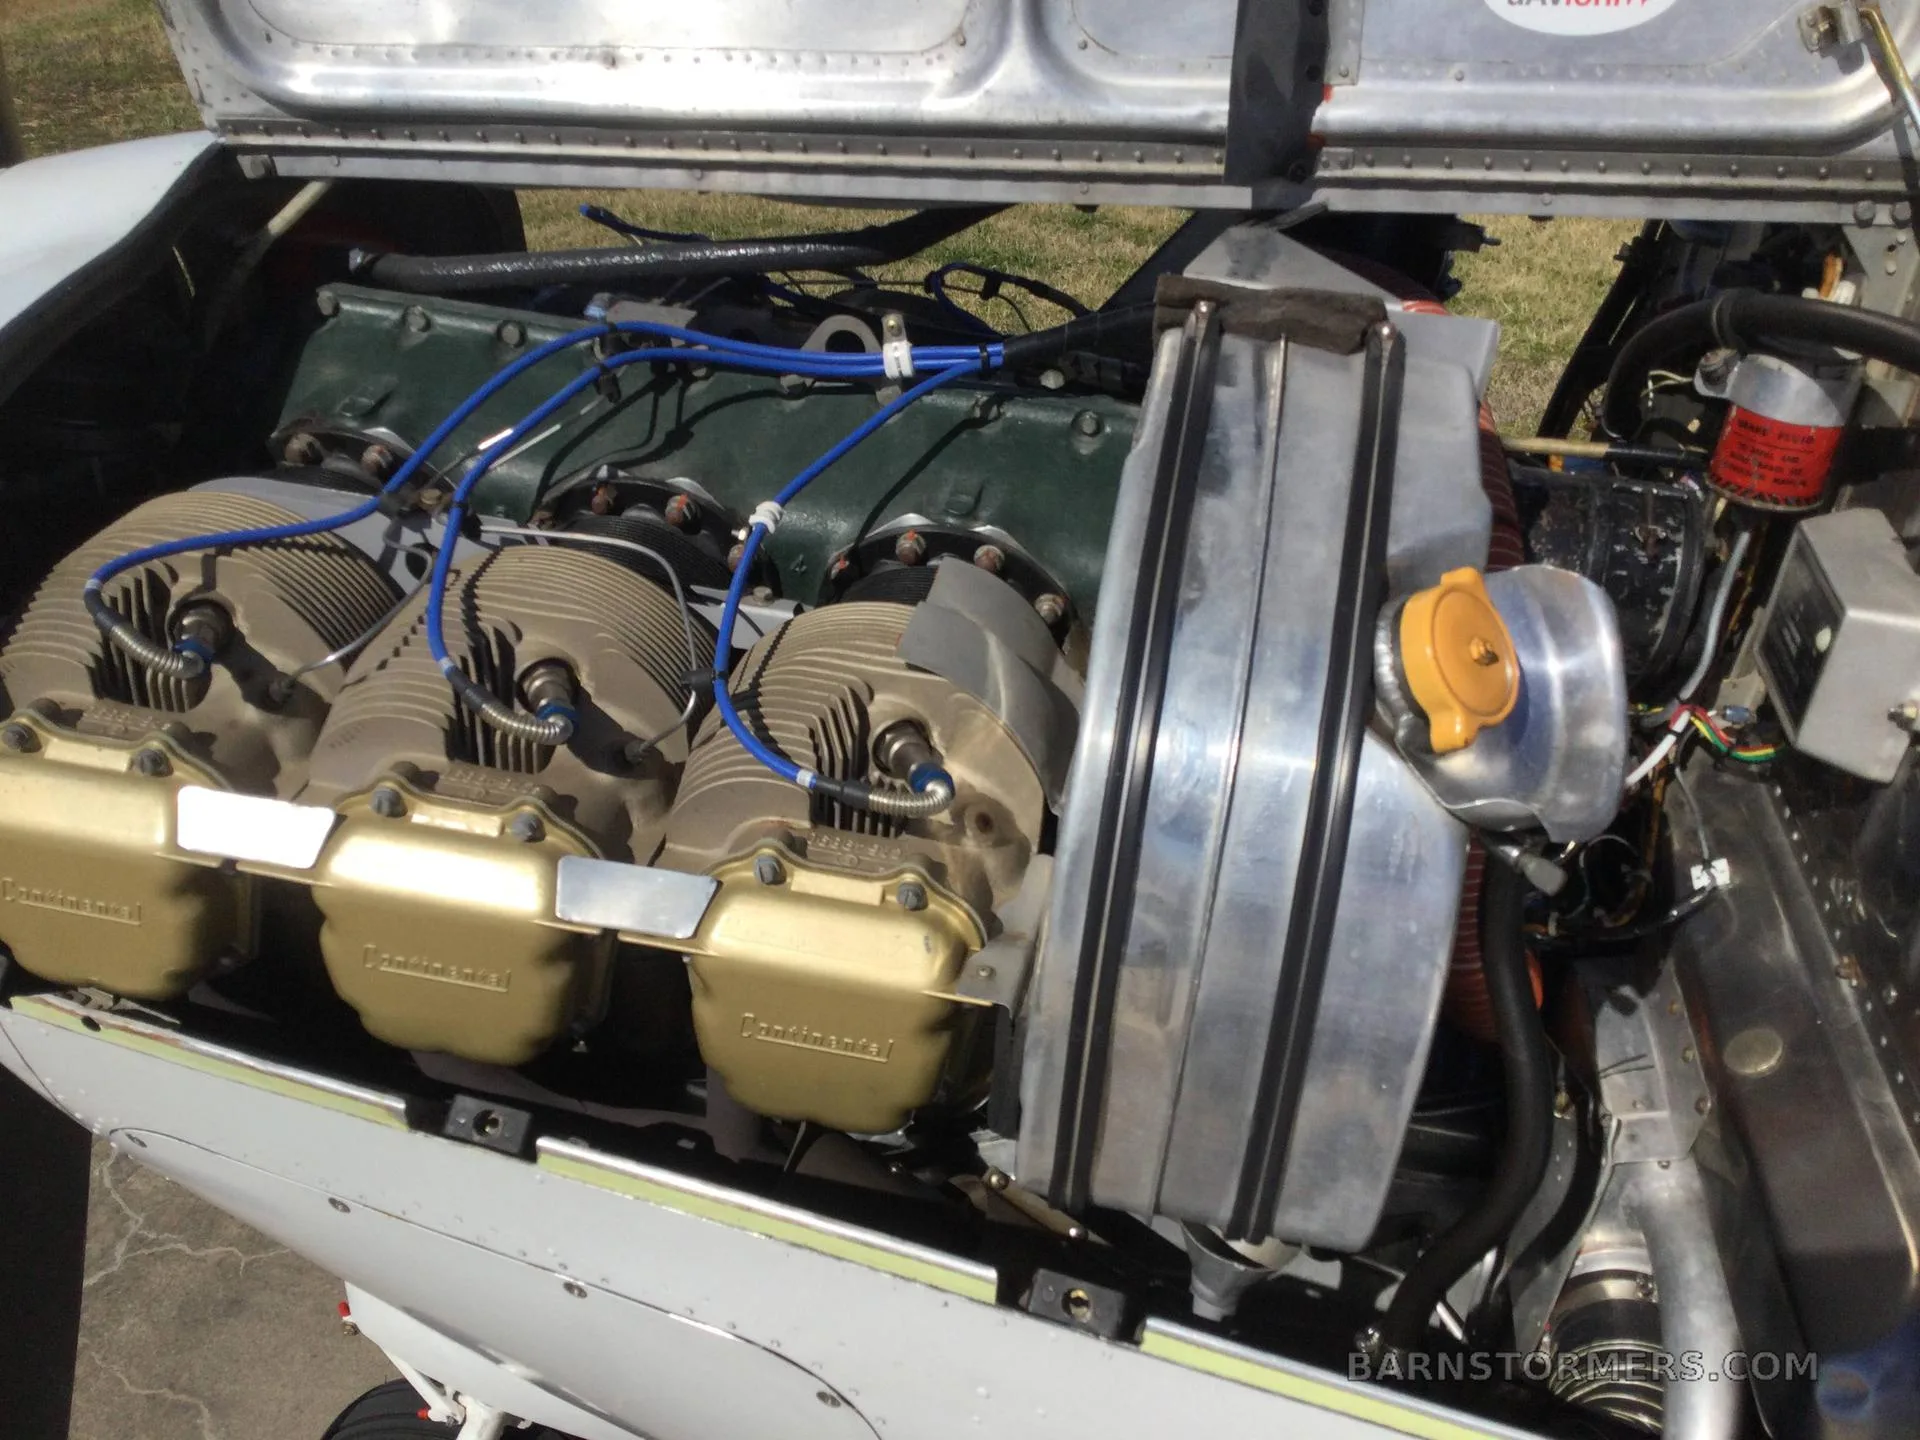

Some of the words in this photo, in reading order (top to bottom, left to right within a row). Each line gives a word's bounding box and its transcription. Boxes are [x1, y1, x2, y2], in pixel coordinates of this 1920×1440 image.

[2, 876, 142, 925] Continental
[363, 944, 511, 991] Continental
[740, 1012, 894, 1063] Continental
